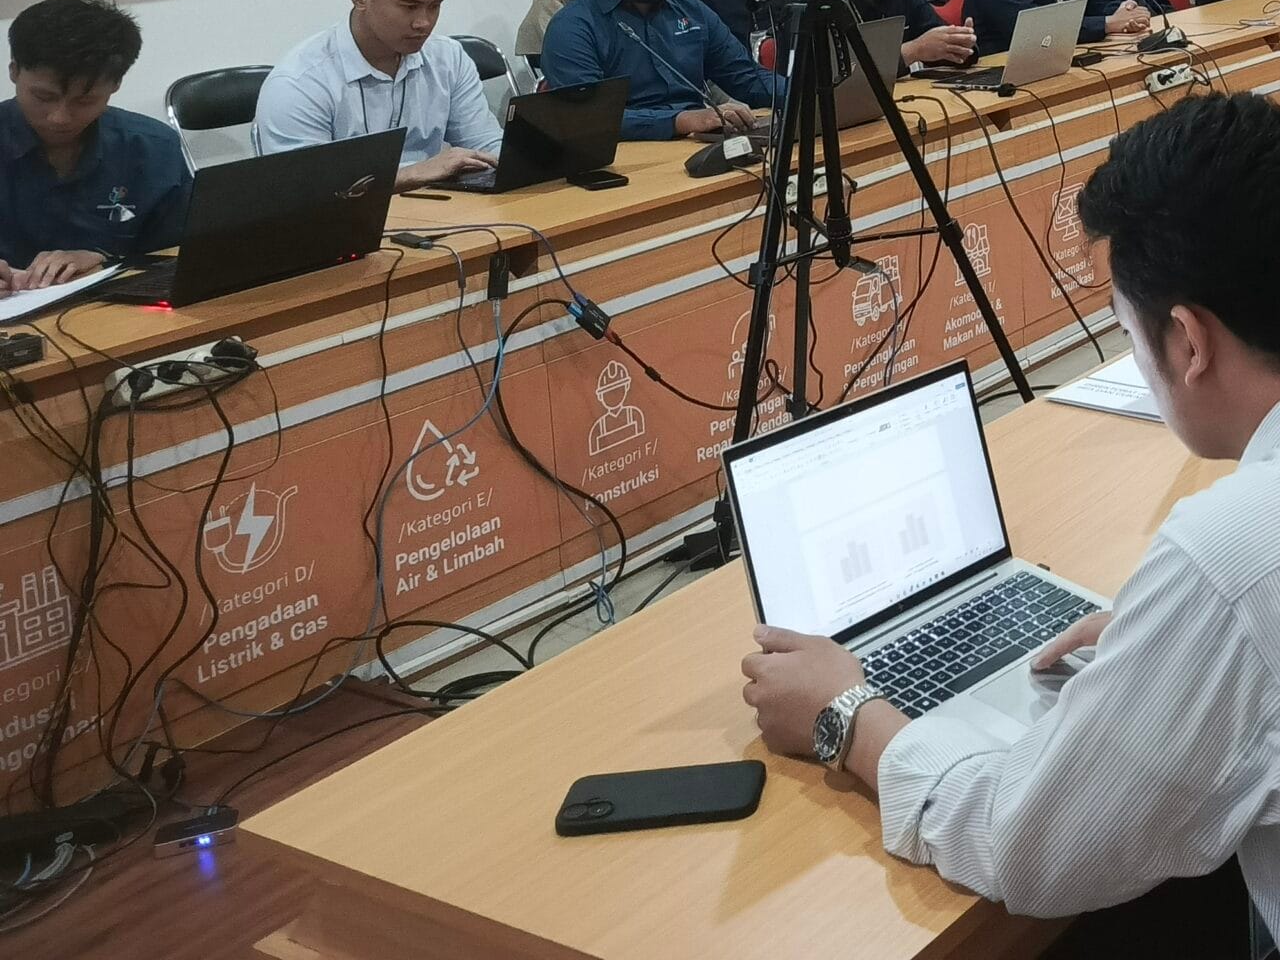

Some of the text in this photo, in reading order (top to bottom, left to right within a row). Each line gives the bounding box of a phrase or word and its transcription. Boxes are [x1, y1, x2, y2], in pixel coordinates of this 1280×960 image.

[996, 298, 1002, 310] &
[850, 323, 894, 354] /Katego
[944, 329, 973, 350] Makan
[582, 438, 658, 487] /Kategori F/
[398, 488, 492, 543] /Kategori E/
[396, 516, 501, 571] Pengelolaan
[396, 536, 504, 595] Air & Limbah
[295, 560, 315, 582] D/
[197, 616, 328, 684] Listrik & Gas
[203, 594, 318, 654] Pengadaan
